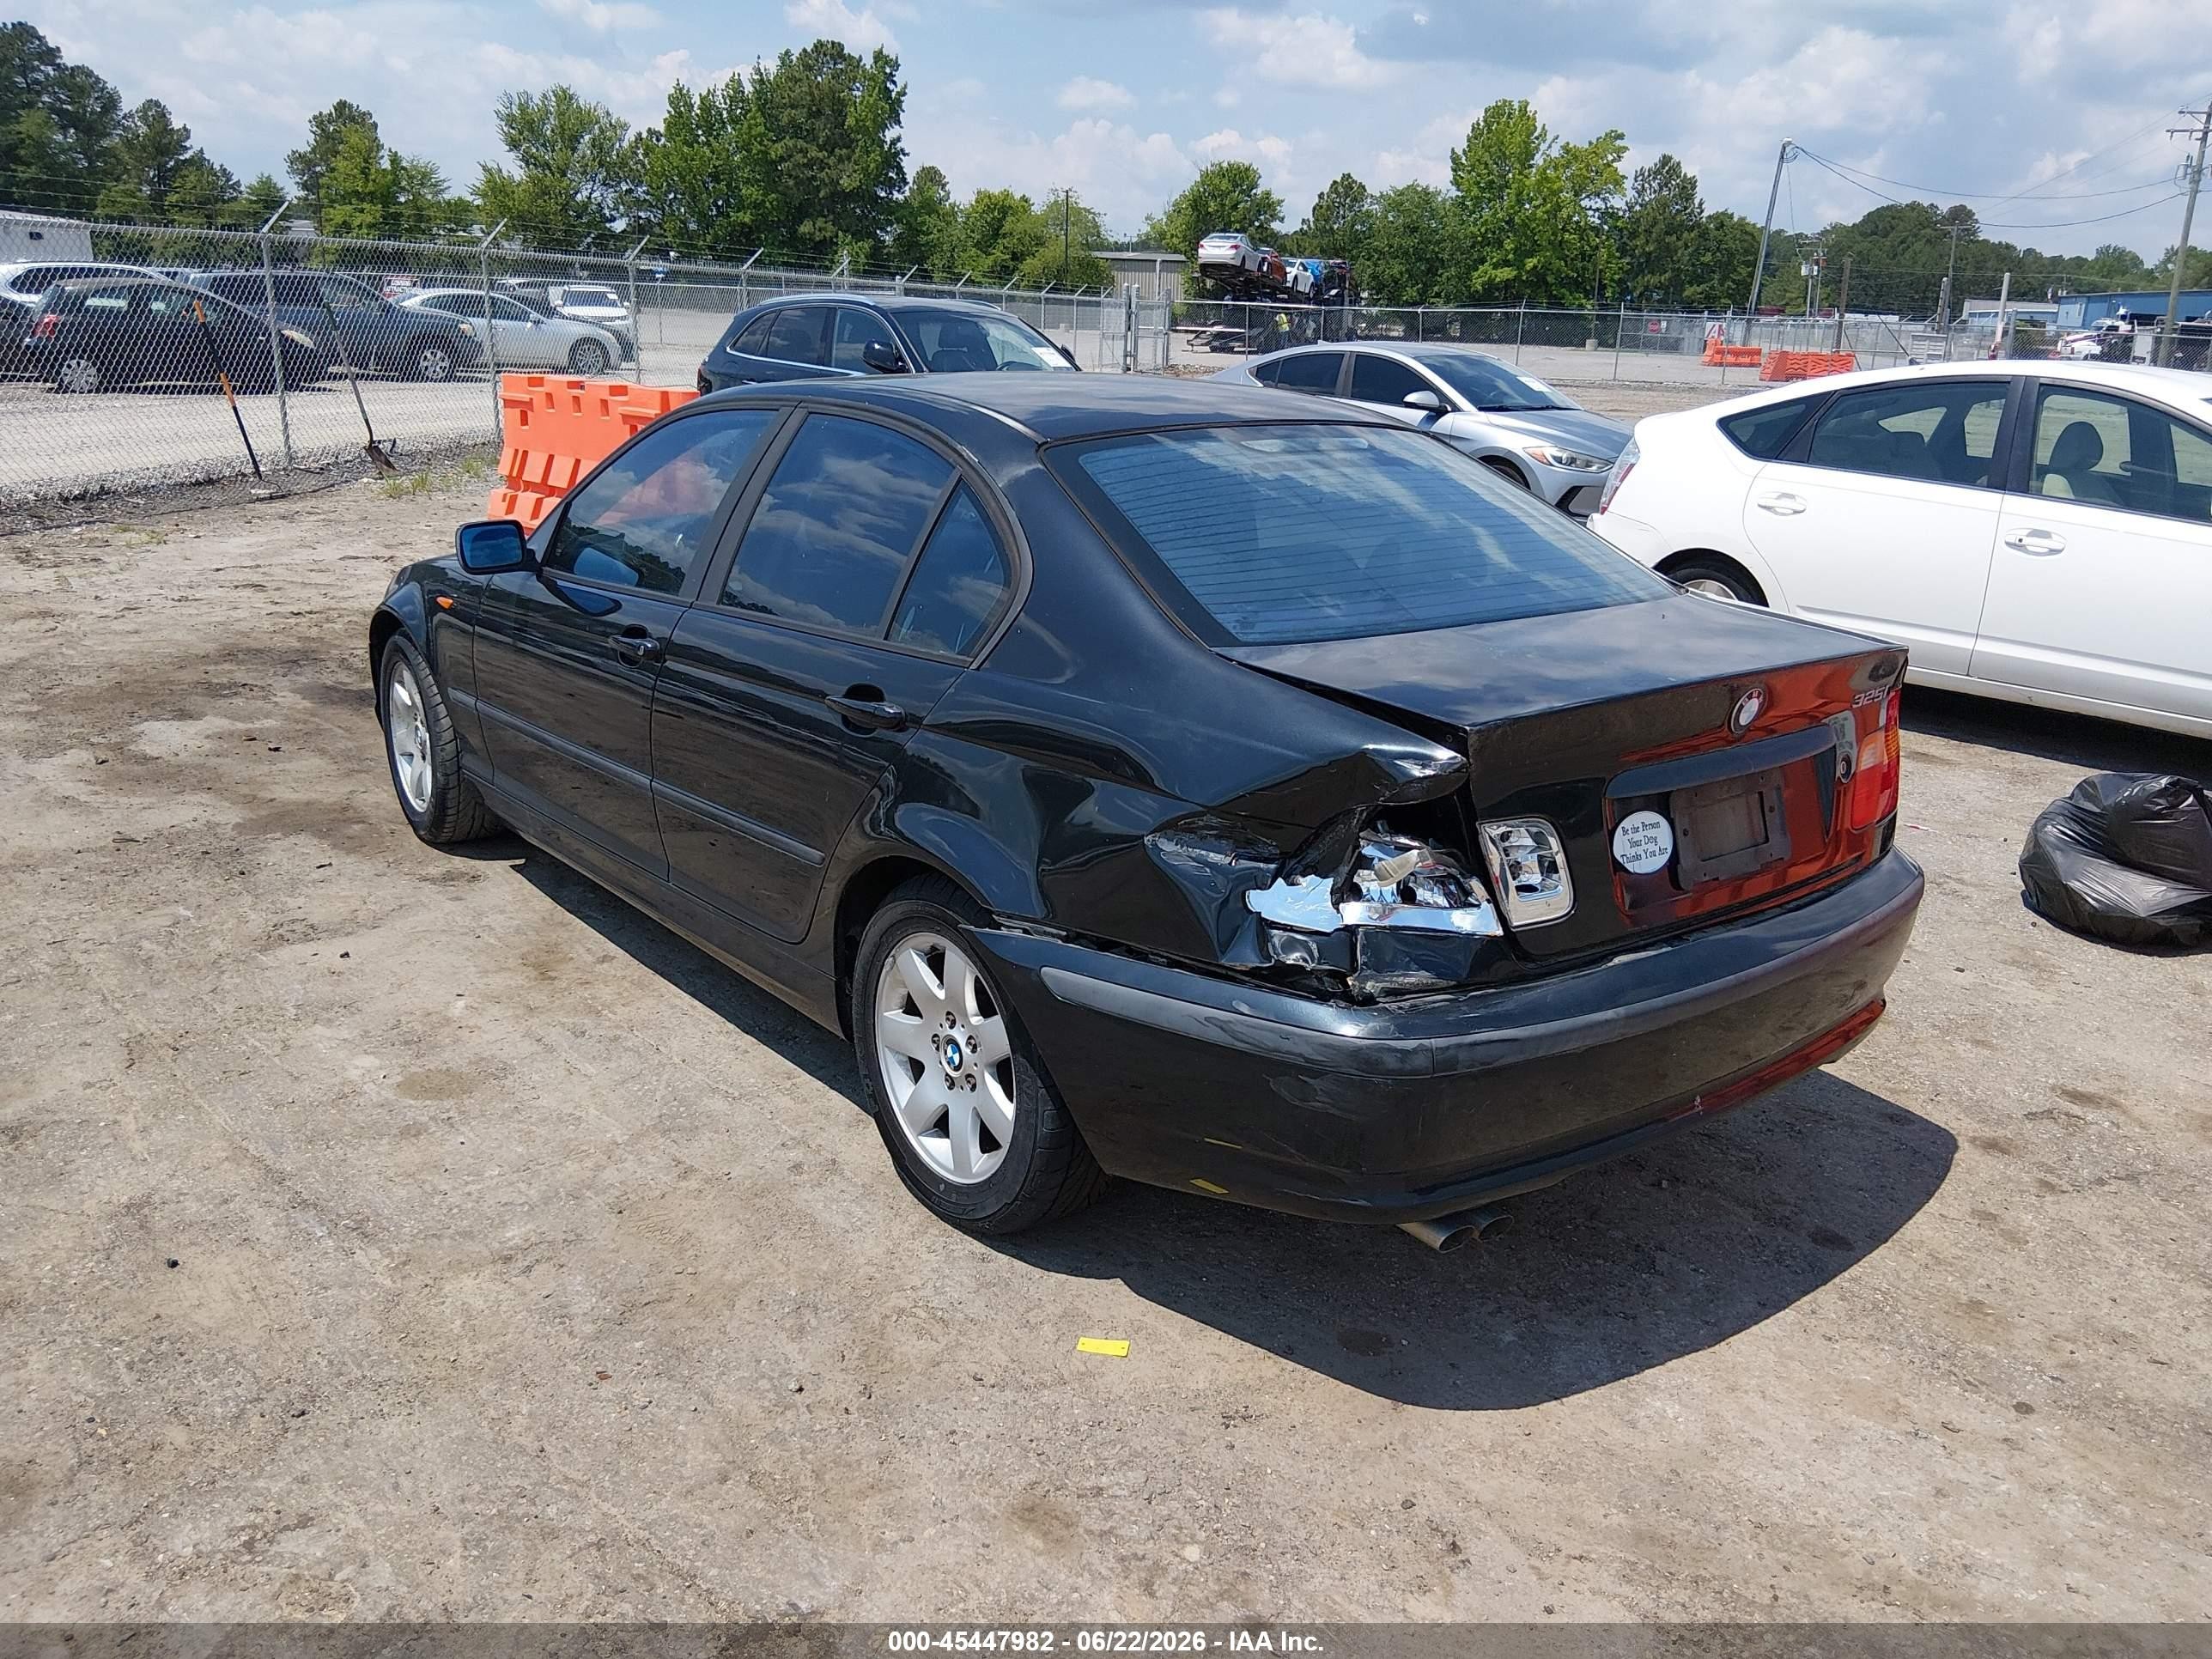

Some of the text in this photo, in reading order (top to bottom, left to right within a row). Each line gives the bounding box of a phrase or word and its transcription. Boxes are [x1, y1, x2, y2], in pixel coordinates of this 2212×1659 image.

[1621, 821, 1661, 836] Be the Person
[1628, 835, 1658, 848] Your Dog
[1620, 846, 1668, 865] Thinks You Are
